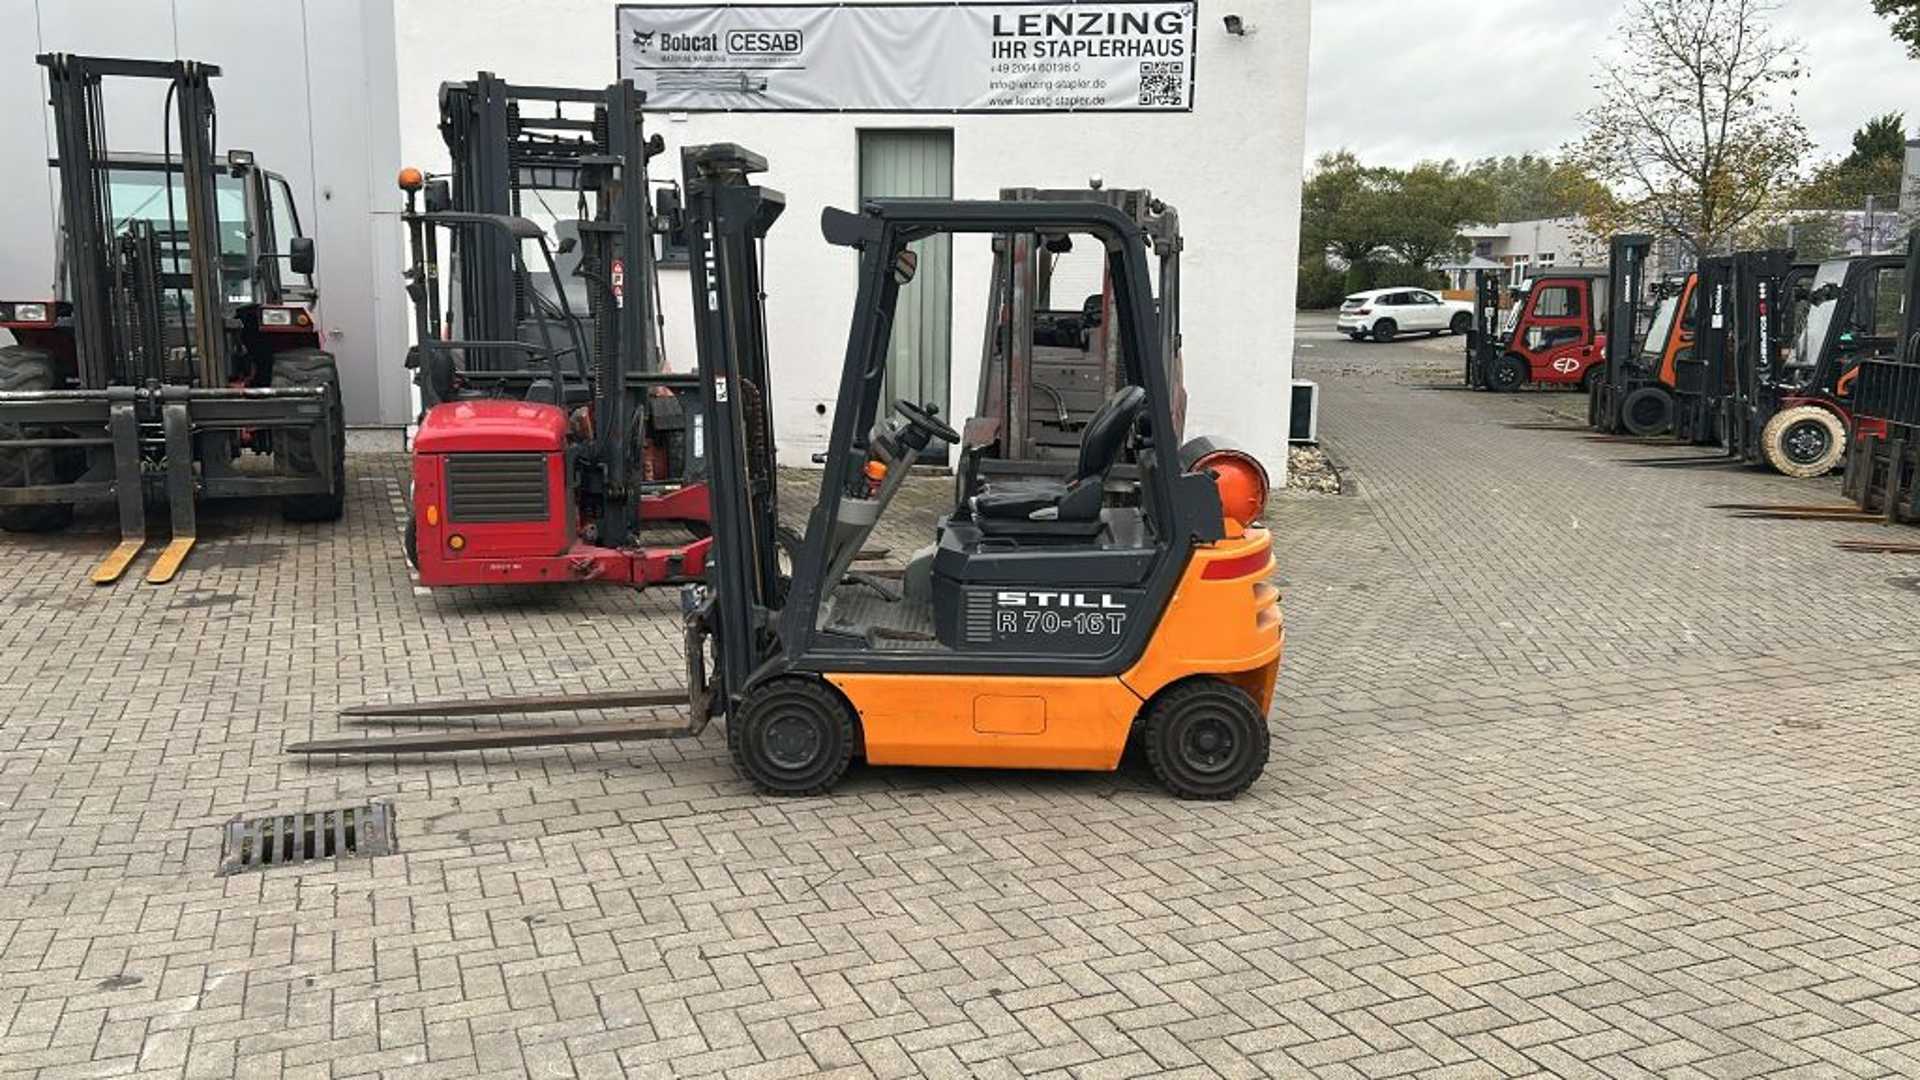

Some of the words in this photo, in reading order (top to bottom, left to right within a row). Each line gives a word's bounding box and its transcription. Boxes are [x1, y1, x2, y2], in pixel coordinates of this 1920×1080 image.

[993, 12, 1183, 36] LENZING
[661, 33, 717, 51] Bobcat
[731, 34, 798, 51] CESAB
[992, 41, 1026, 58] IHR
[1034, 40, 1184, 58] STAPLERHAUS
[703, 221, 719, 311] STILL
[997, 592, 1126, 608] STILL
[997, 610, 1017, 632] R
